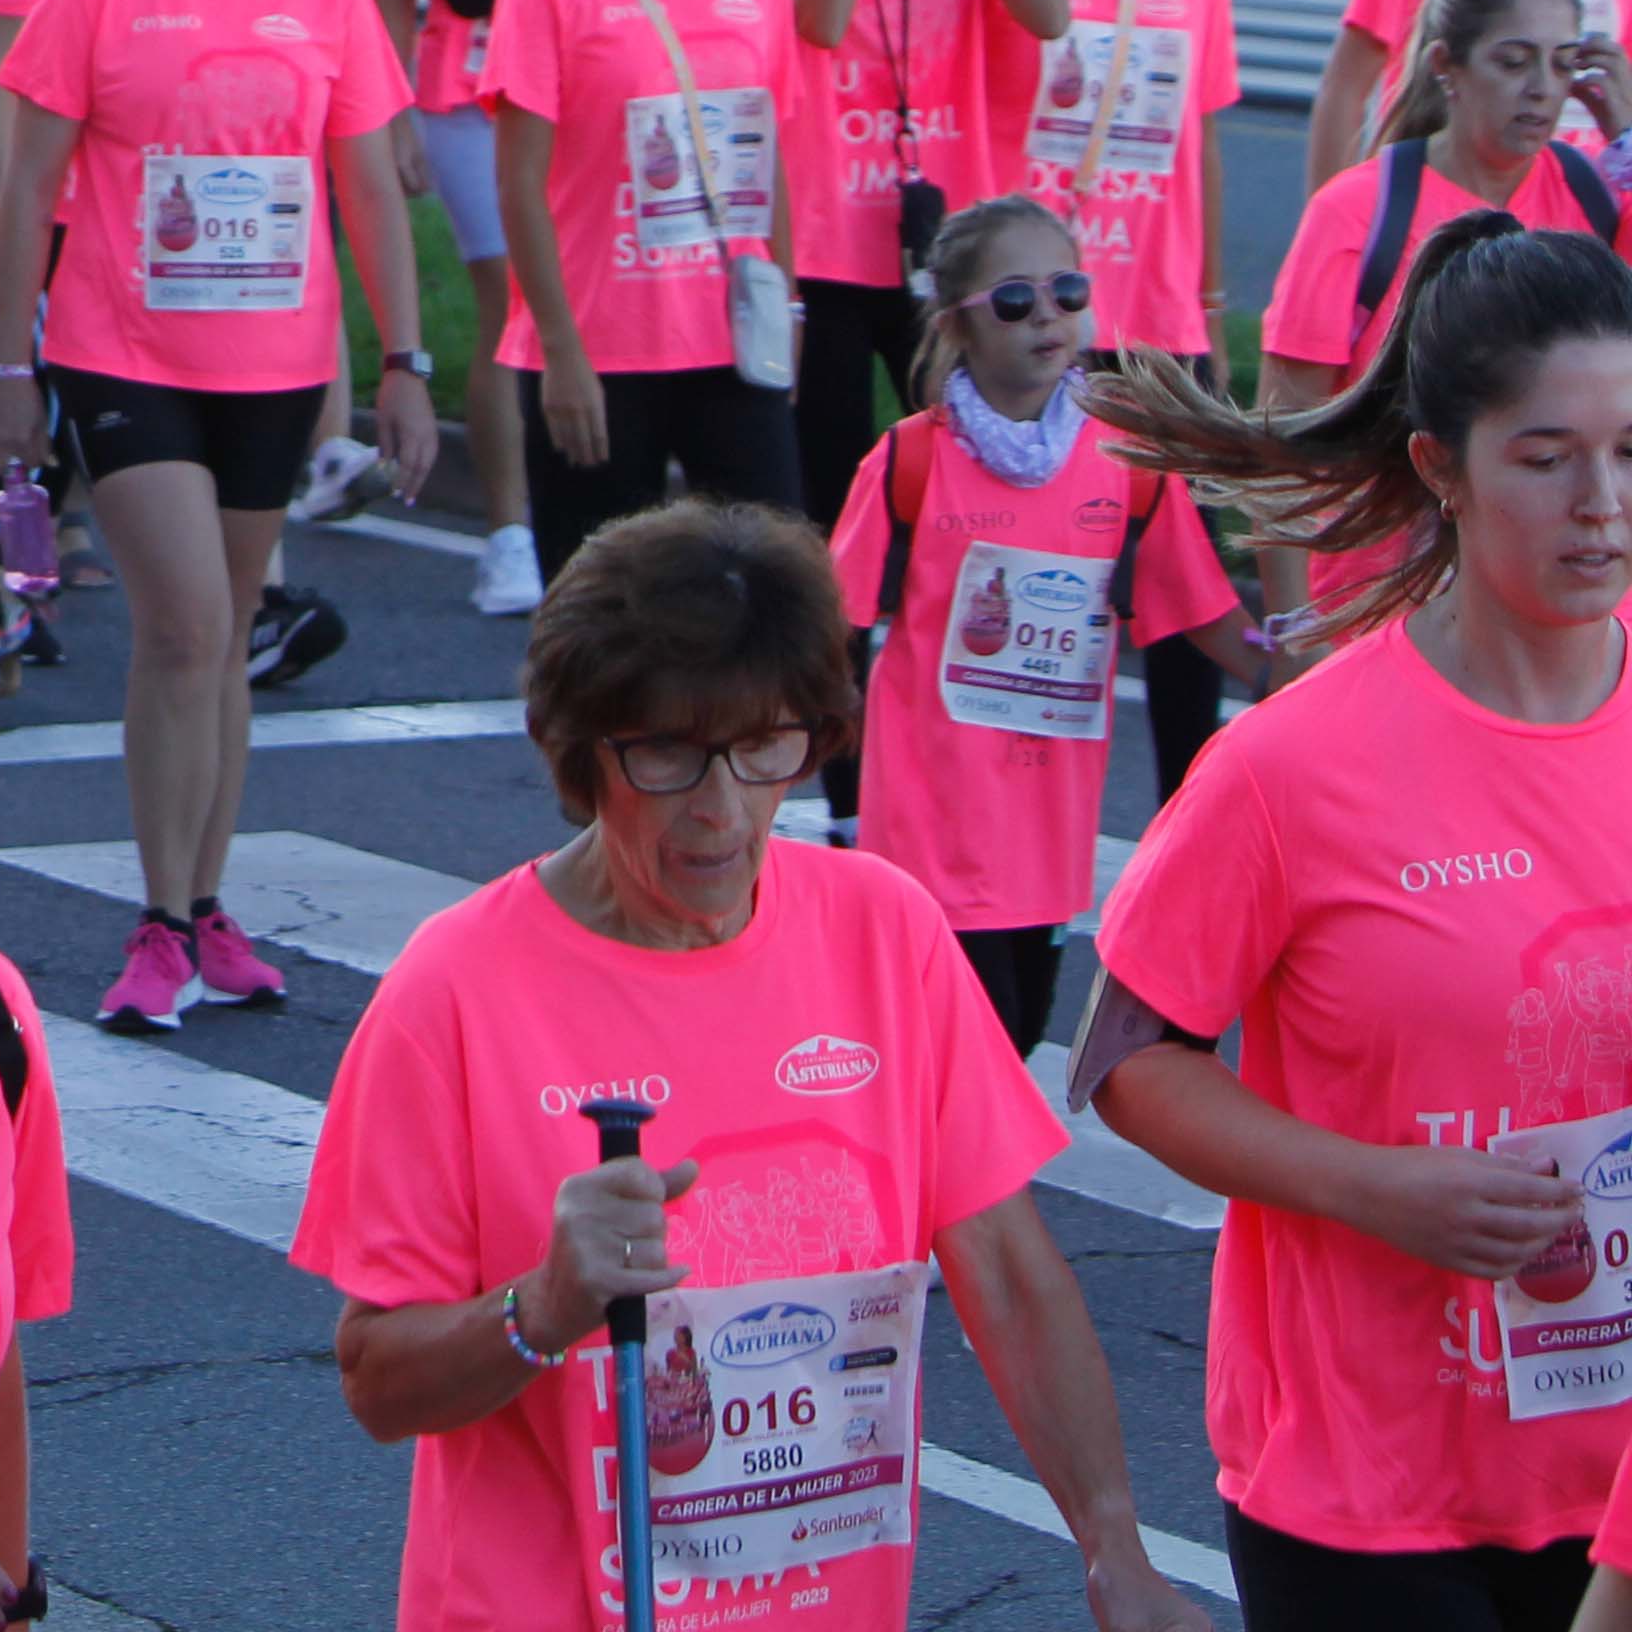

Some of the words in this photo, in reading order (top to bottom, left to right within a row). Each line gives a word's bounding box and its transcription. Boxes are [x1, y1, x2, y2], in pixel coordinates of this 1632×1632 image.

[204, 218, 259, 239] 016
[936, 510, 1016, 534] OYSHO
[1016, 623, 1078, 653] 016
[1400, 847, 1533, 893] OYSHO
[786, 1058, 872, 1086] ASTURIANA
[540, 1074, 672, 1116] OYSHO
[848, 1301, 901, 1323] SUMA
[720, 1328, 826, 1359] ASTURIANA
[1537, 1322, 1620, 1346] CARRERA
[1534, 1360, 1625, 1393] OYSHO
[722, 1385, 817, 1438] 016
[743, 1443, 804, 1476] 5880
[657, 1494, 738, 1519] CARRERA
[742, 1490, 767, 1507] DE
[770, 1486, 792, 1503] LA
[794, 1475, 844, 1498] MUJER
[848, 1464, 880, 1486] 2023
[810, 1504, 886, 1537] Santander
[789, 1586, 830, 1609] 2023
[702, 1610, 721, 1628] LA
[723, 1599, 772, 1624] MUJER
